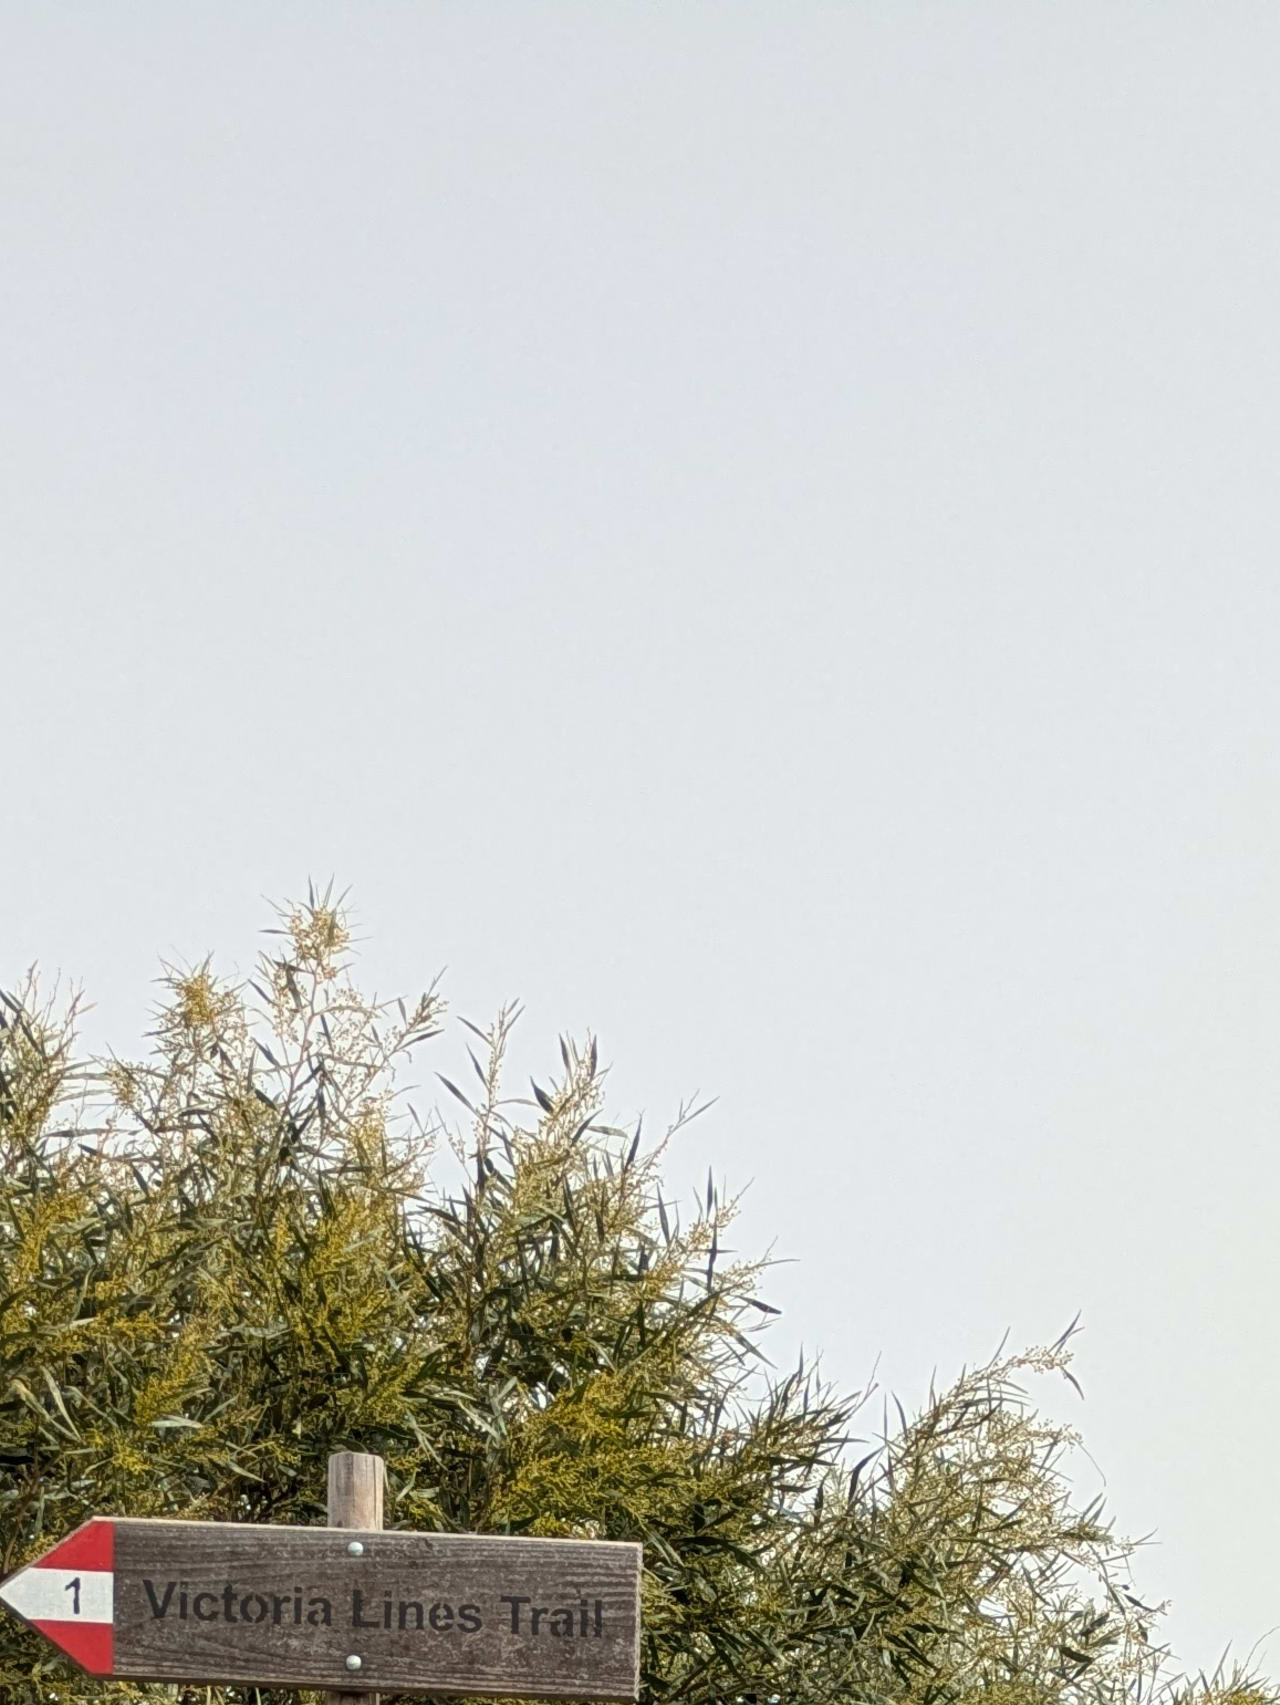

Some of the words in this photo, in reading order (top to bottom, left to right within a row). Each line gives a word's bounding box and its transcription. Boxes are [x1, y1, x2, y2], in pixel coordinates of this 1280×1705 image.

[64, 1577, 82, 1614] 1
[143, 1579, 332, 1627] Victoria
[352, 1588, 483, 1634] Lines
[502, 1596, 604, 1638] Trail
